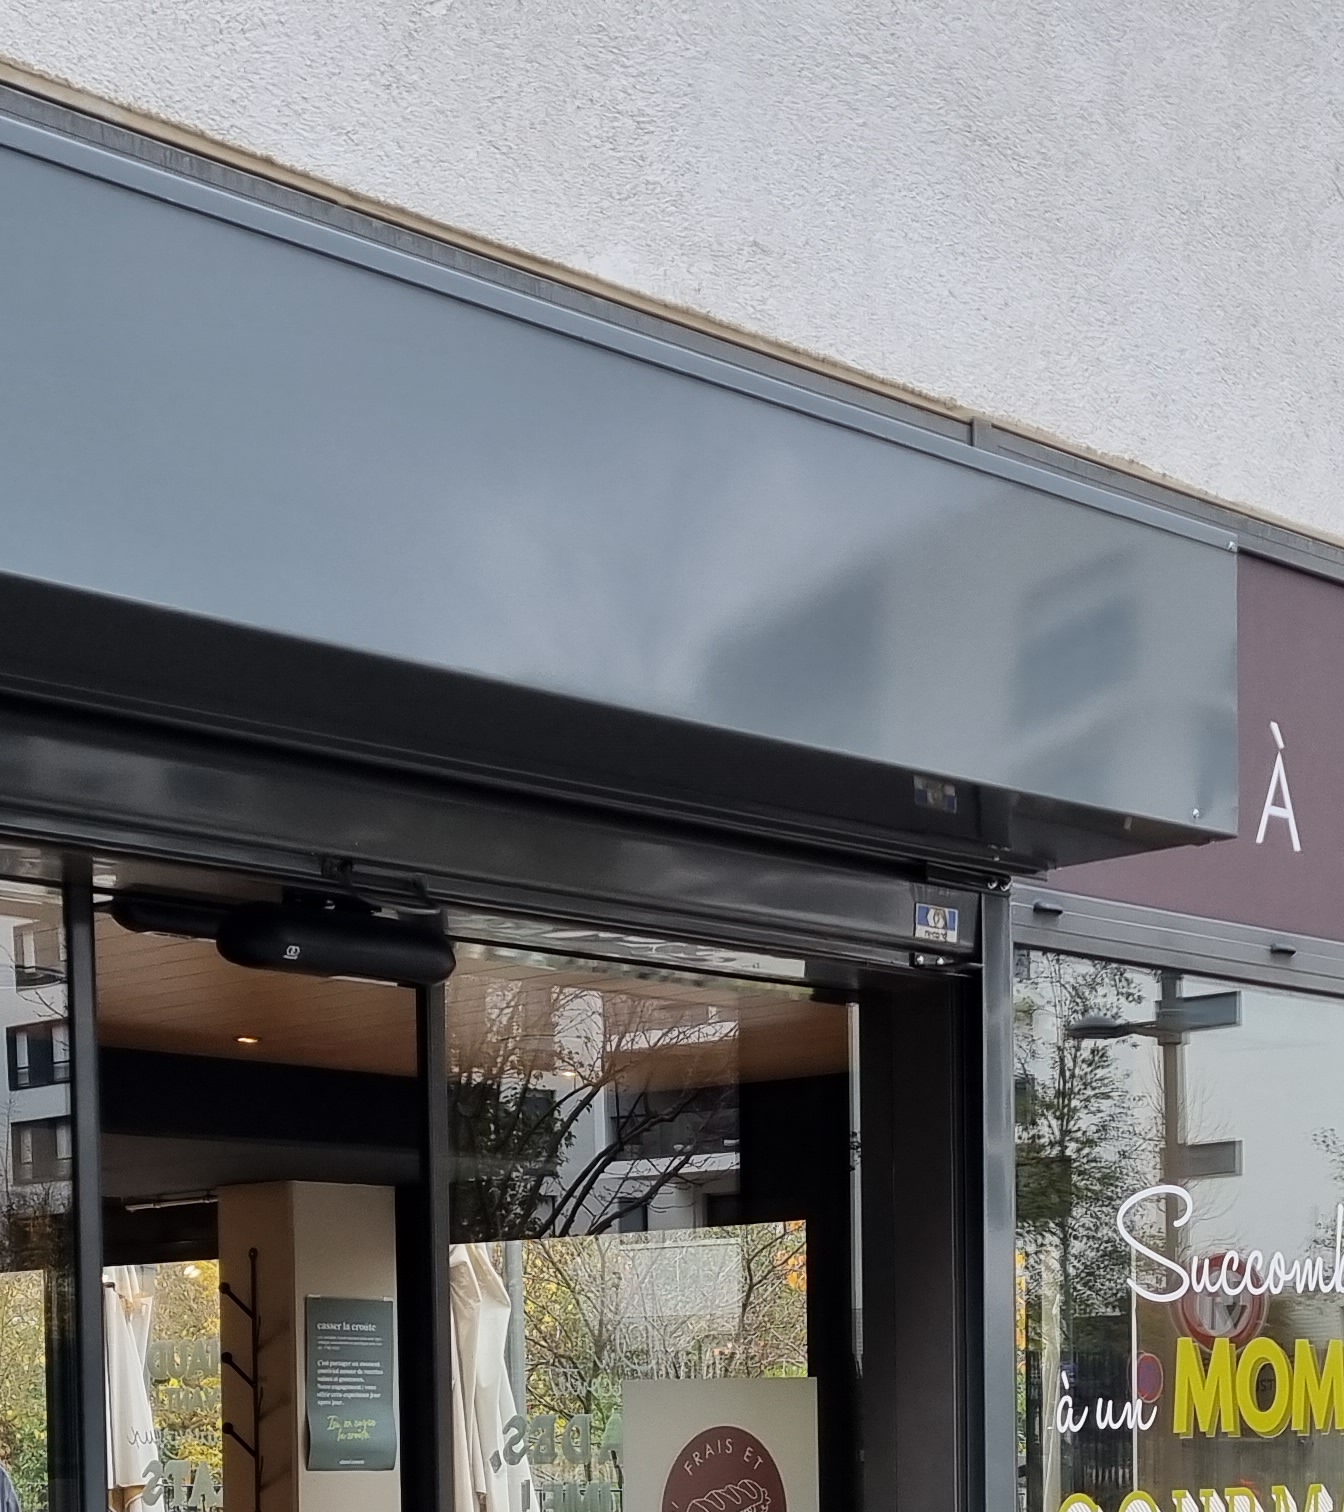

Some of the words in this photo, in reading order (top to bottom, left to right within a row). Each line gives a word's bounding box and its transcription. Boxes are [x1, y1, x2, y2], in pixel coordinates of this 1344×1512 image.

[1255, 720, 1303, 853] À
[1054, 1370, 1089, 1434] à
[1095, 1391, 1157, 1433] un
[683, 1438, 733, 1476] FRAIS
[743, 1447, 764, 1470] ET
